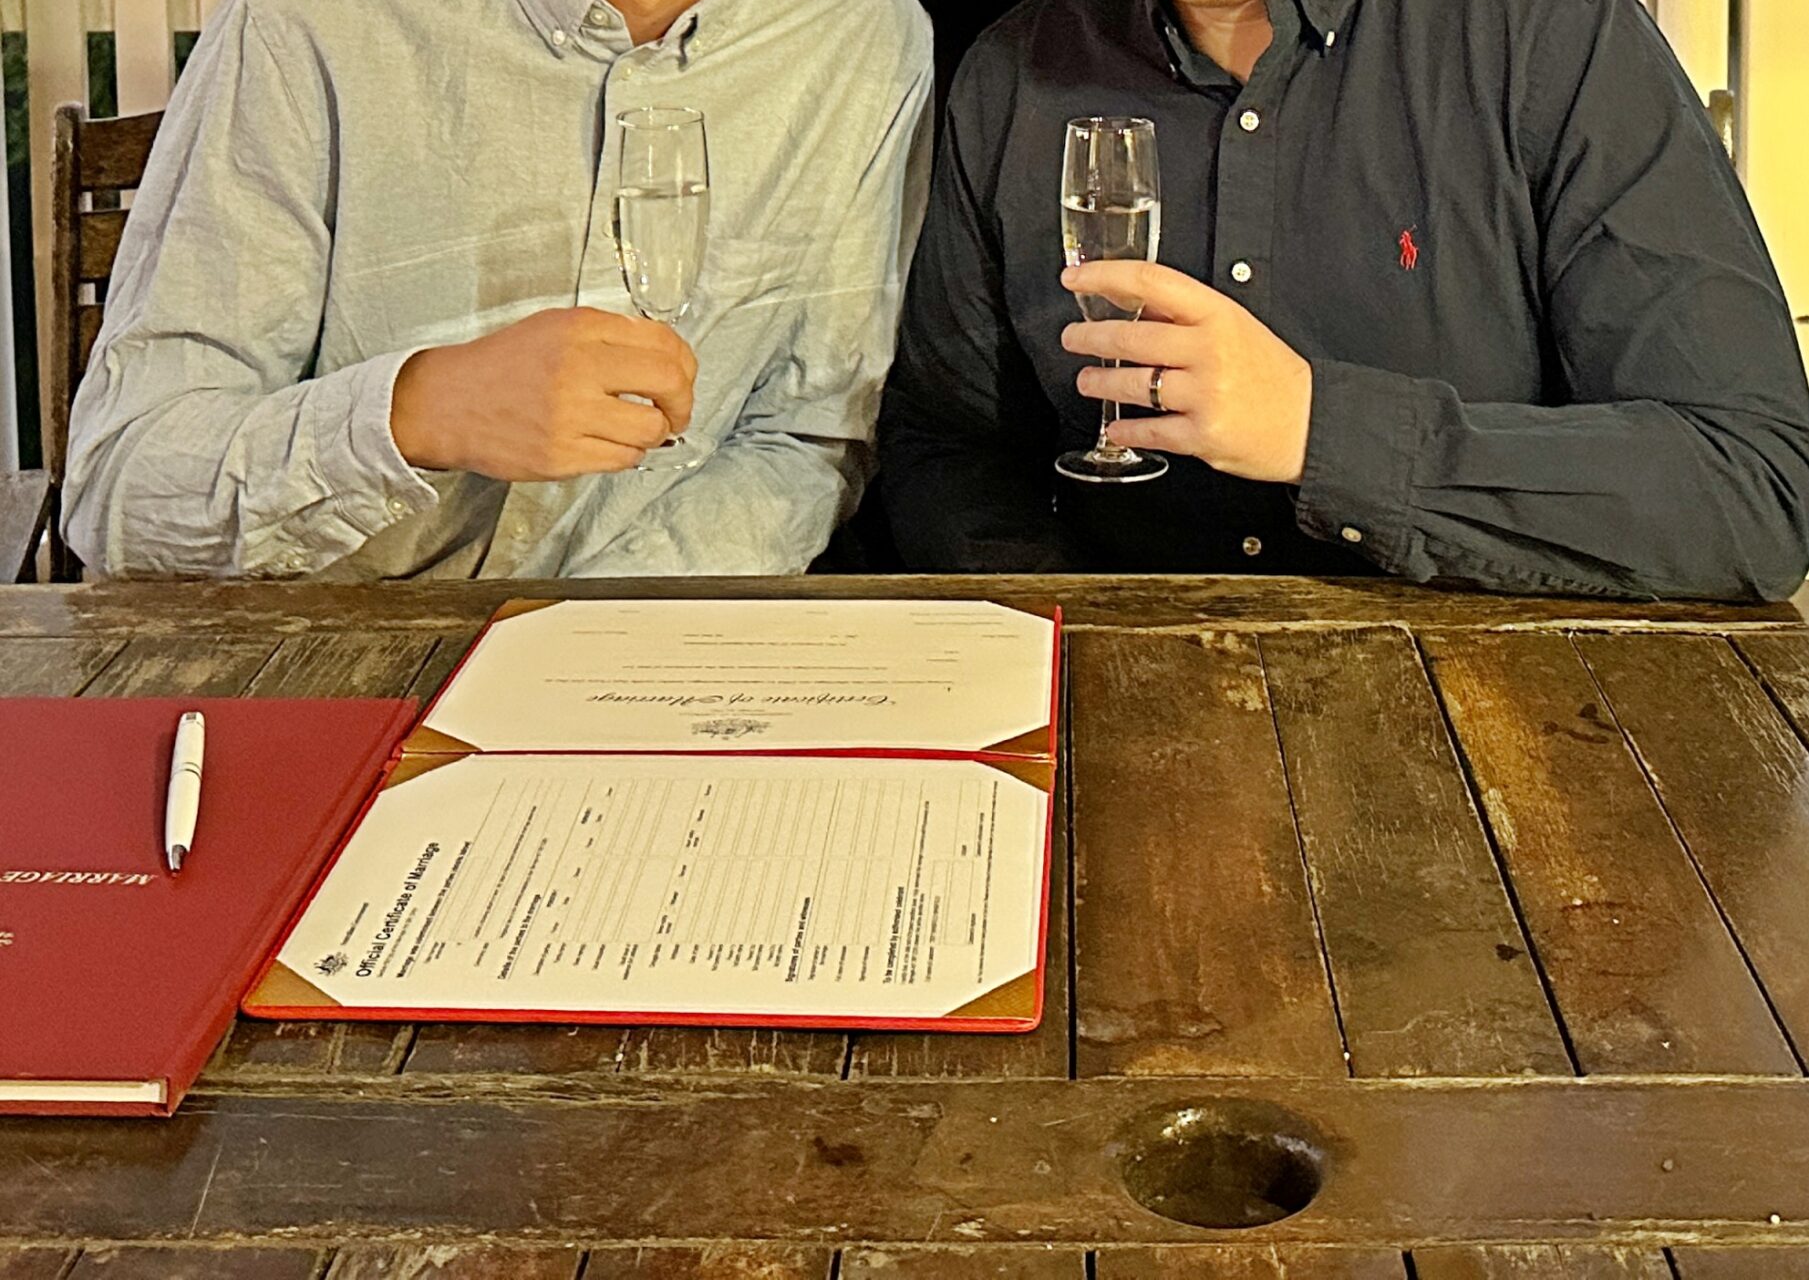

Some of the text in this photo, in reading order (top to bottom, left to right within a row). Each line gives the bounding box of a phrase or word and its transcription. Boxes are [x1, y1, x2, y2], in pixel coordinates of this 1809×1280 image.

[586, 692, 896, 706] Certificate of Marriage
[0, 871, 158, 885] MARRIAGE
[356, 843, 440, 977] Official Certificate of Marriage
